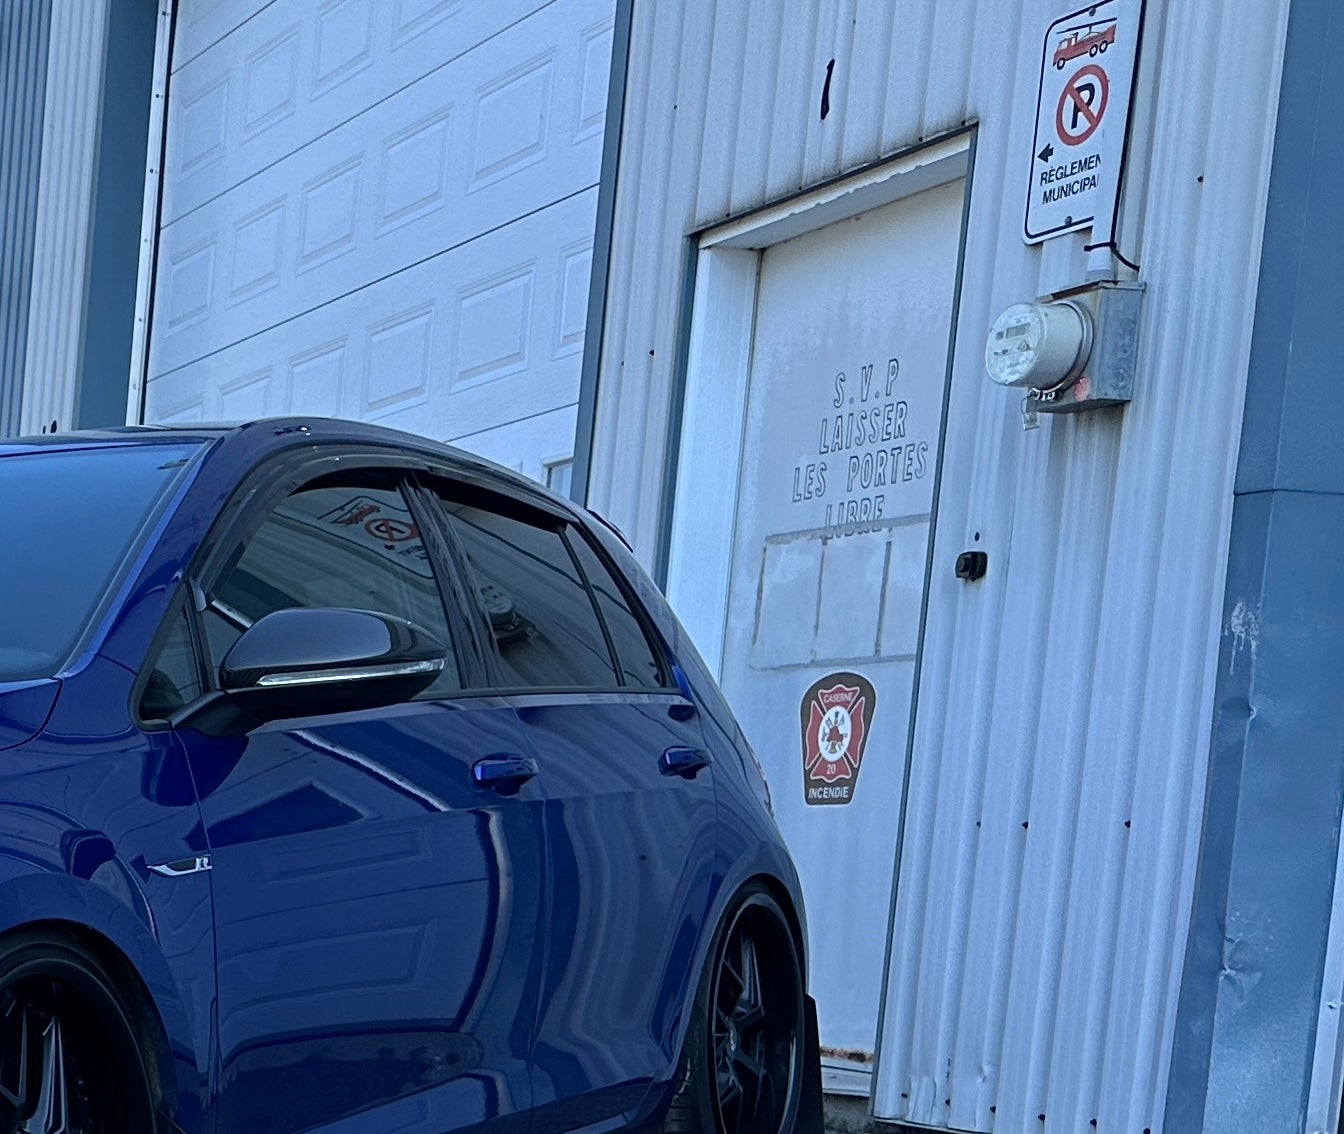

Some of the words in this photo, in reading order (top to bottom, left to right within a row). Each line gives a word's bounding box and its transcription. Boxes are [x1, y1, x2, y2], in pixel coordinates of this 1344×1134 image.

[1071, 82, 1095, 130] P
[1040, 153, 1102, 187] RÈGLEMEN
[1042, 173, 1100, 205] MUNICIPA
[818, 400, 908, 455] LAISSER
[792, 461, 827, 502] LES
[846, 441, 929, 493] PORTES
[818, 494, 885, 541] LIBRE
[826, 763, 837, 775] 20
[808, 786, 849, 799] INCENDIE
